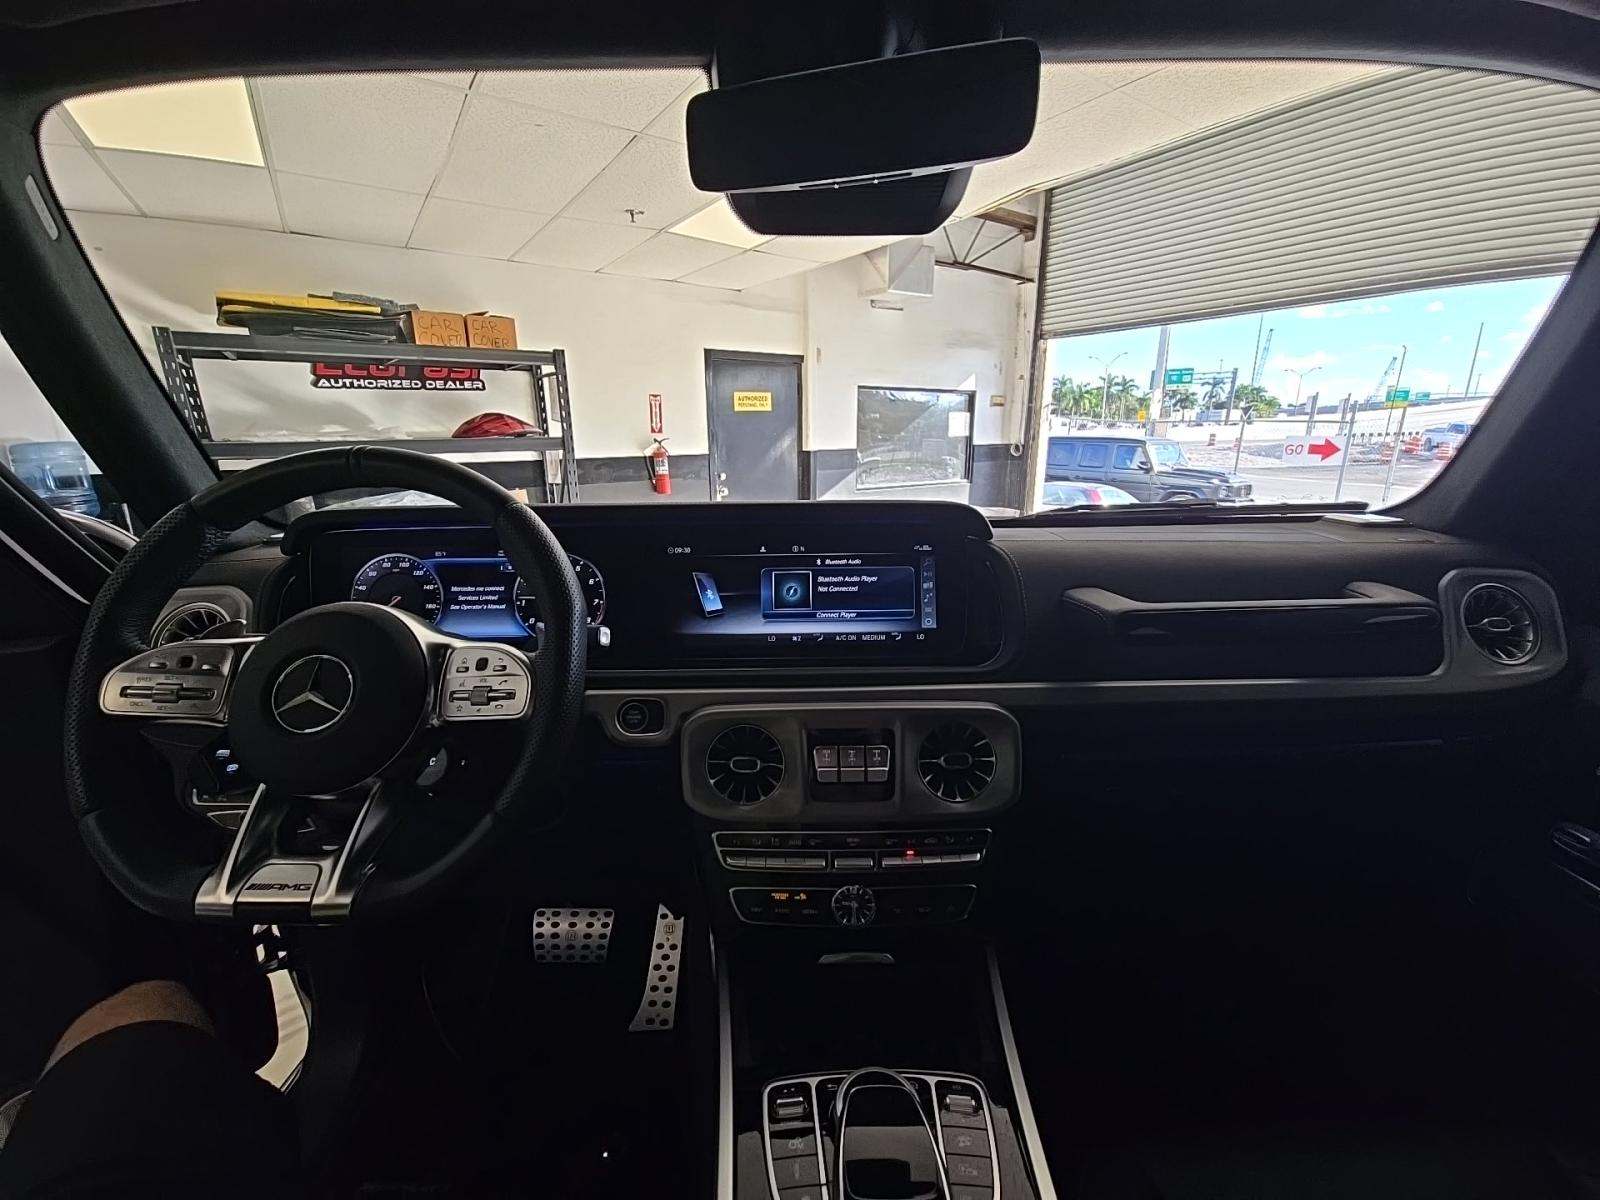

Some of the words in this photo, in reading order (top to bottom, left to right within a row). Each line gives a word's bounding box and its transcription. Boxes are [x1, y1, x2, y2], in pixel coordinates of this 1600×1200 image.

[417, 315, 460, 332] CAR
[472, 319, 502, 334] CAR
[473, 333, 511, 347] COVER
[317, 378, 422, 389] AUTHORIZED
[425, 380, 483, 390] DEALER
[1285, 444, 1304, 455] GO
[861, 575, 878, 583] Player
[840, 611, 857, 619] Player
